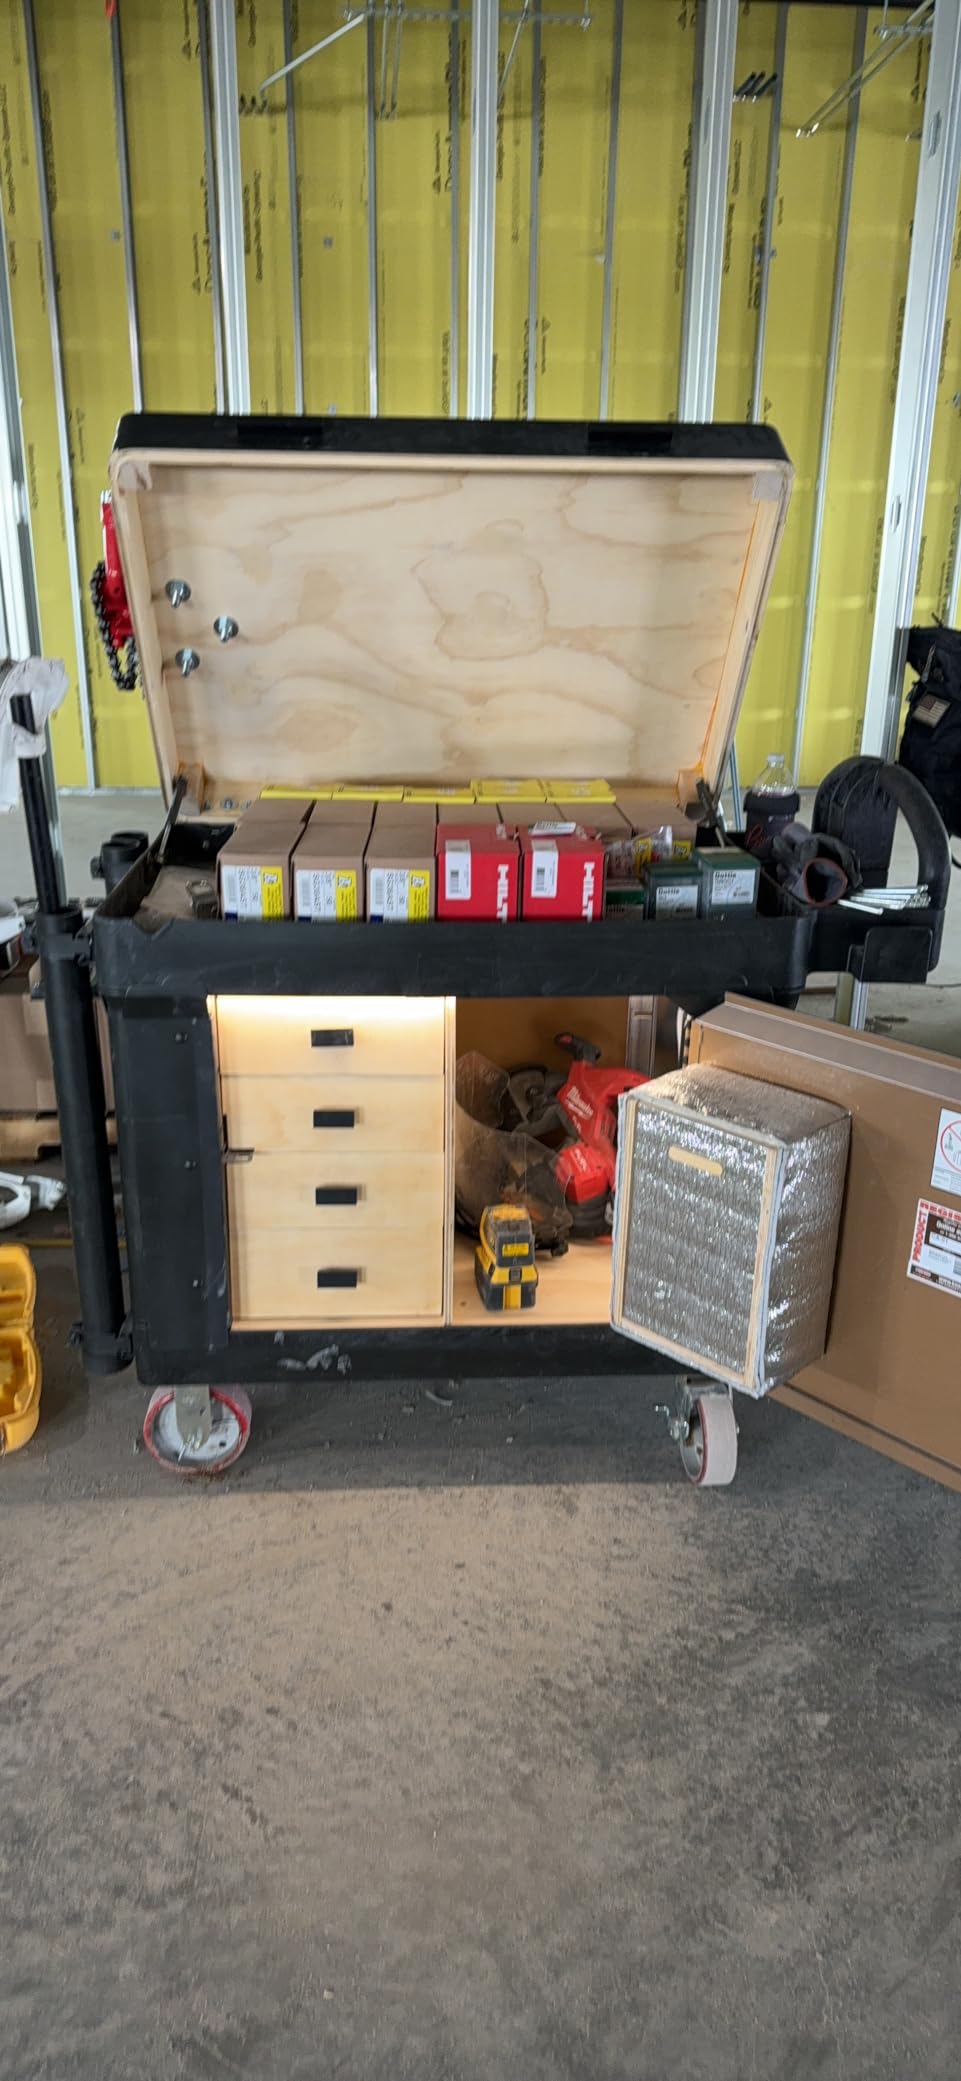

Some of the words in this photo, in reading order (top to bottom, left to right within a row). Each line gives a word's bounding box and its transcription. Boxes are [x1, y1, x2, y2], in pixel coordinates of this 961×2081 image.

[714, 871, 737, 879] Dottie
[658, 887, 680, 895] Dottie
[913, 1211, 927, 1263] PRODUCT
